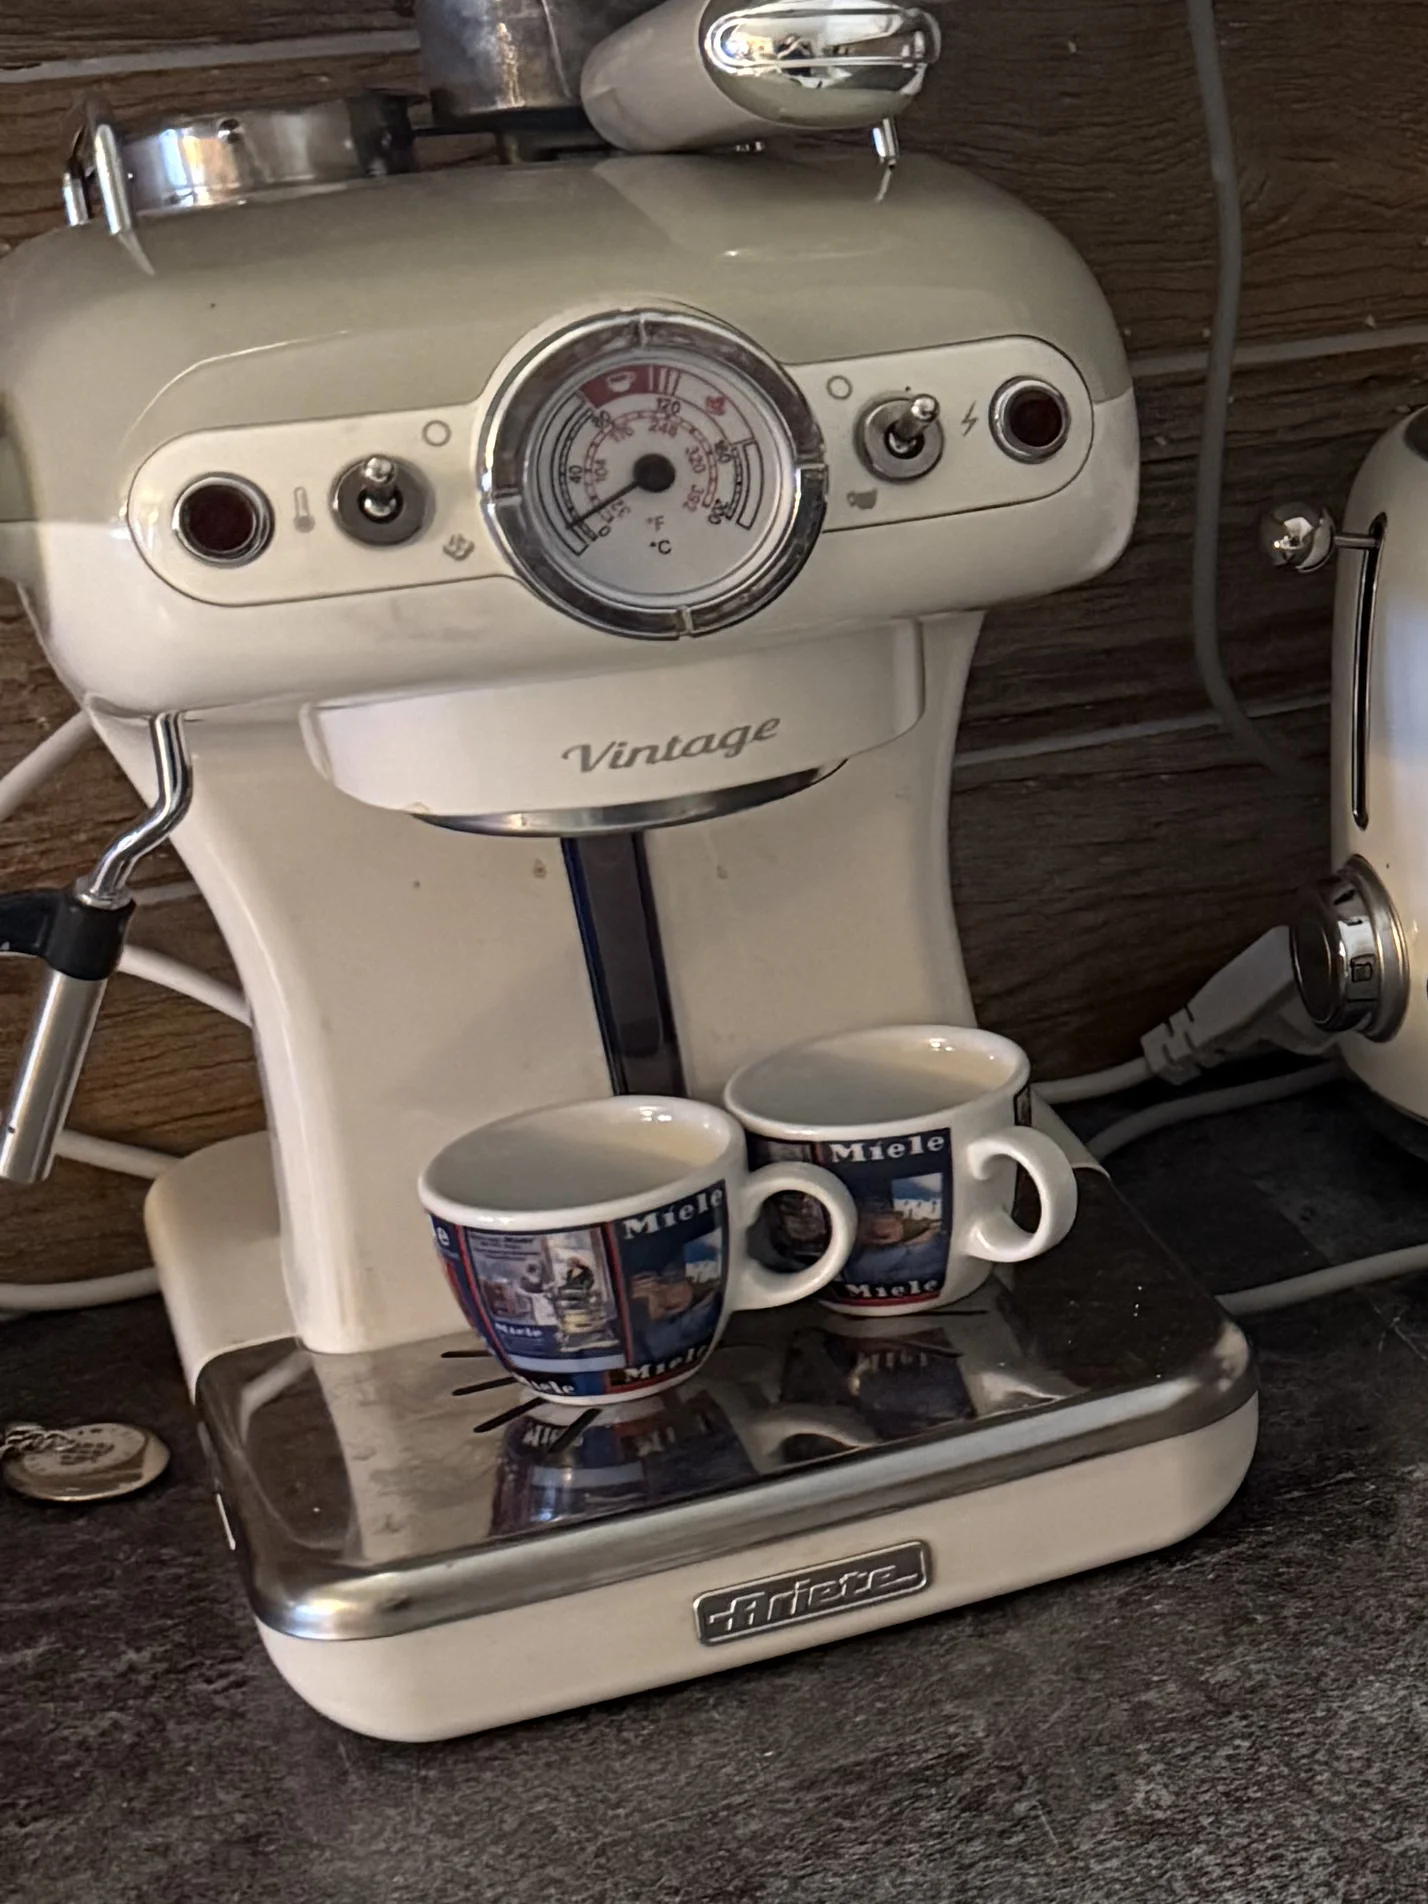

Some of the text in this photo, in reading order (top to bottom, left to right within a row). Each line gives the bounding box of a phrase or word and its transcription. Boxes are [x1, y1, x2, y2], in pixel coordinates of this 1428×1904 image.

[656, 398, 681, 414] 120
[568, 465, 582, 484] 40
[598, 525, 611, 538] 0
[561, 717, 781, 774] Vintage
[830, 1133, 946, 1164] Miele
[622, 1187, 724, 1240] Miele
[846, 1278, 940, 1299] Miele
[708, 1564, 918, 1632] Ariete
